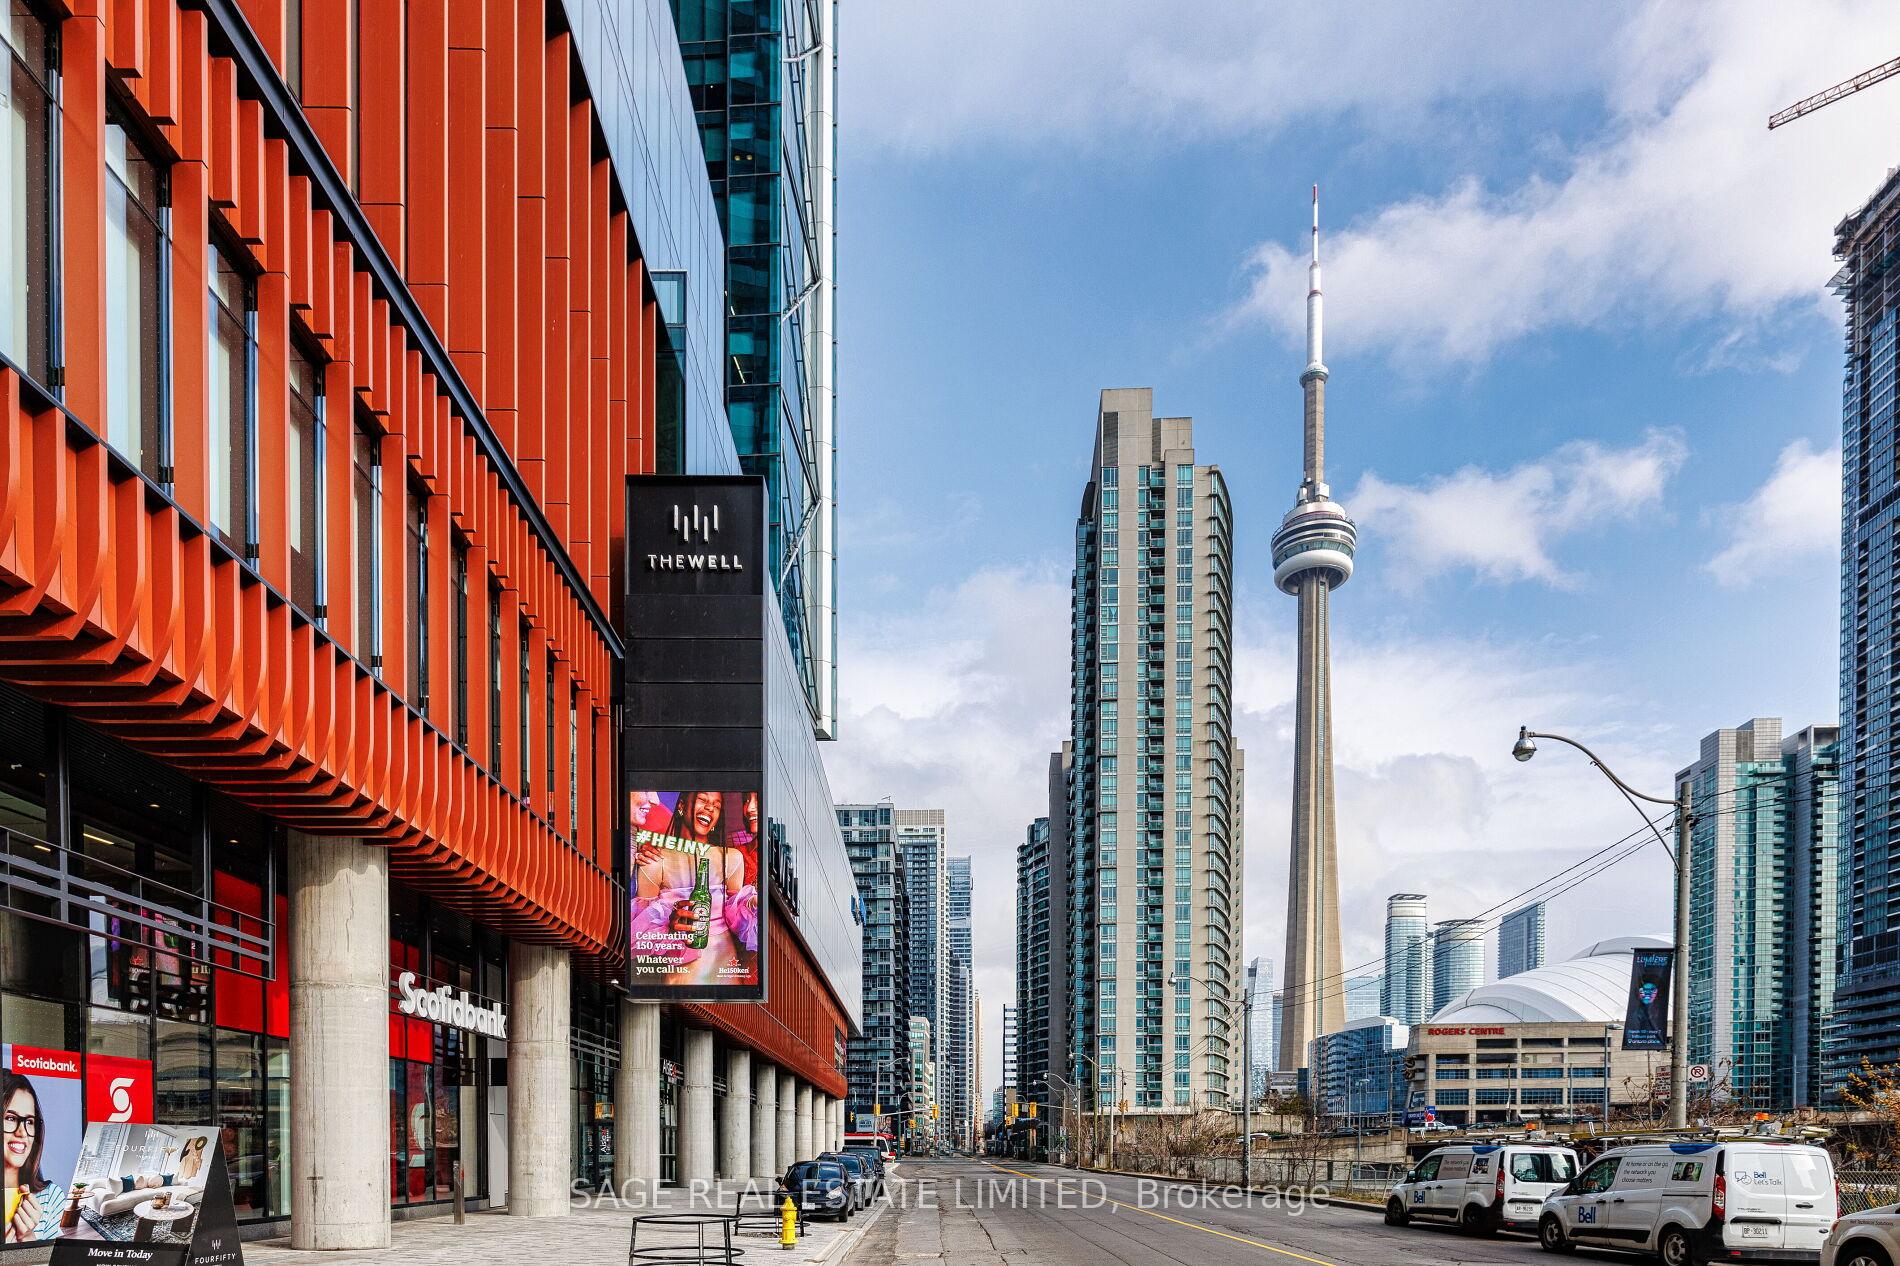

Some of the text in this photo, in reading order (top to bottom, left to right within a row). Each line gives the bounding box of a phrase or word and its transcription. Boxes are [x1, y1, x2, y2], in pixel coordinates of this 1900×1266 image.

[636, 830, 711, 857] #HEINY
[635, 931, 695, 942] Celebrating
[636, 941, 685, 951] 150 years.
[636, 955, 685, 964] Whatever
[636, 965, 691, 975] you call us.
[398, 971, 507, 1039] Scotiabank
[1427, 1027, 1505, 1036] ROGERS CENTRE
[1753, 1171, 1767, 1179] Bell
[1414, 1191, 1426, 1203] Bell
[1578, 1205, 1596, 1224] Bell
[88, 1248, 153, 1260] Move in Today
[194, 1253, 237, 1265] FOURFIFTY
